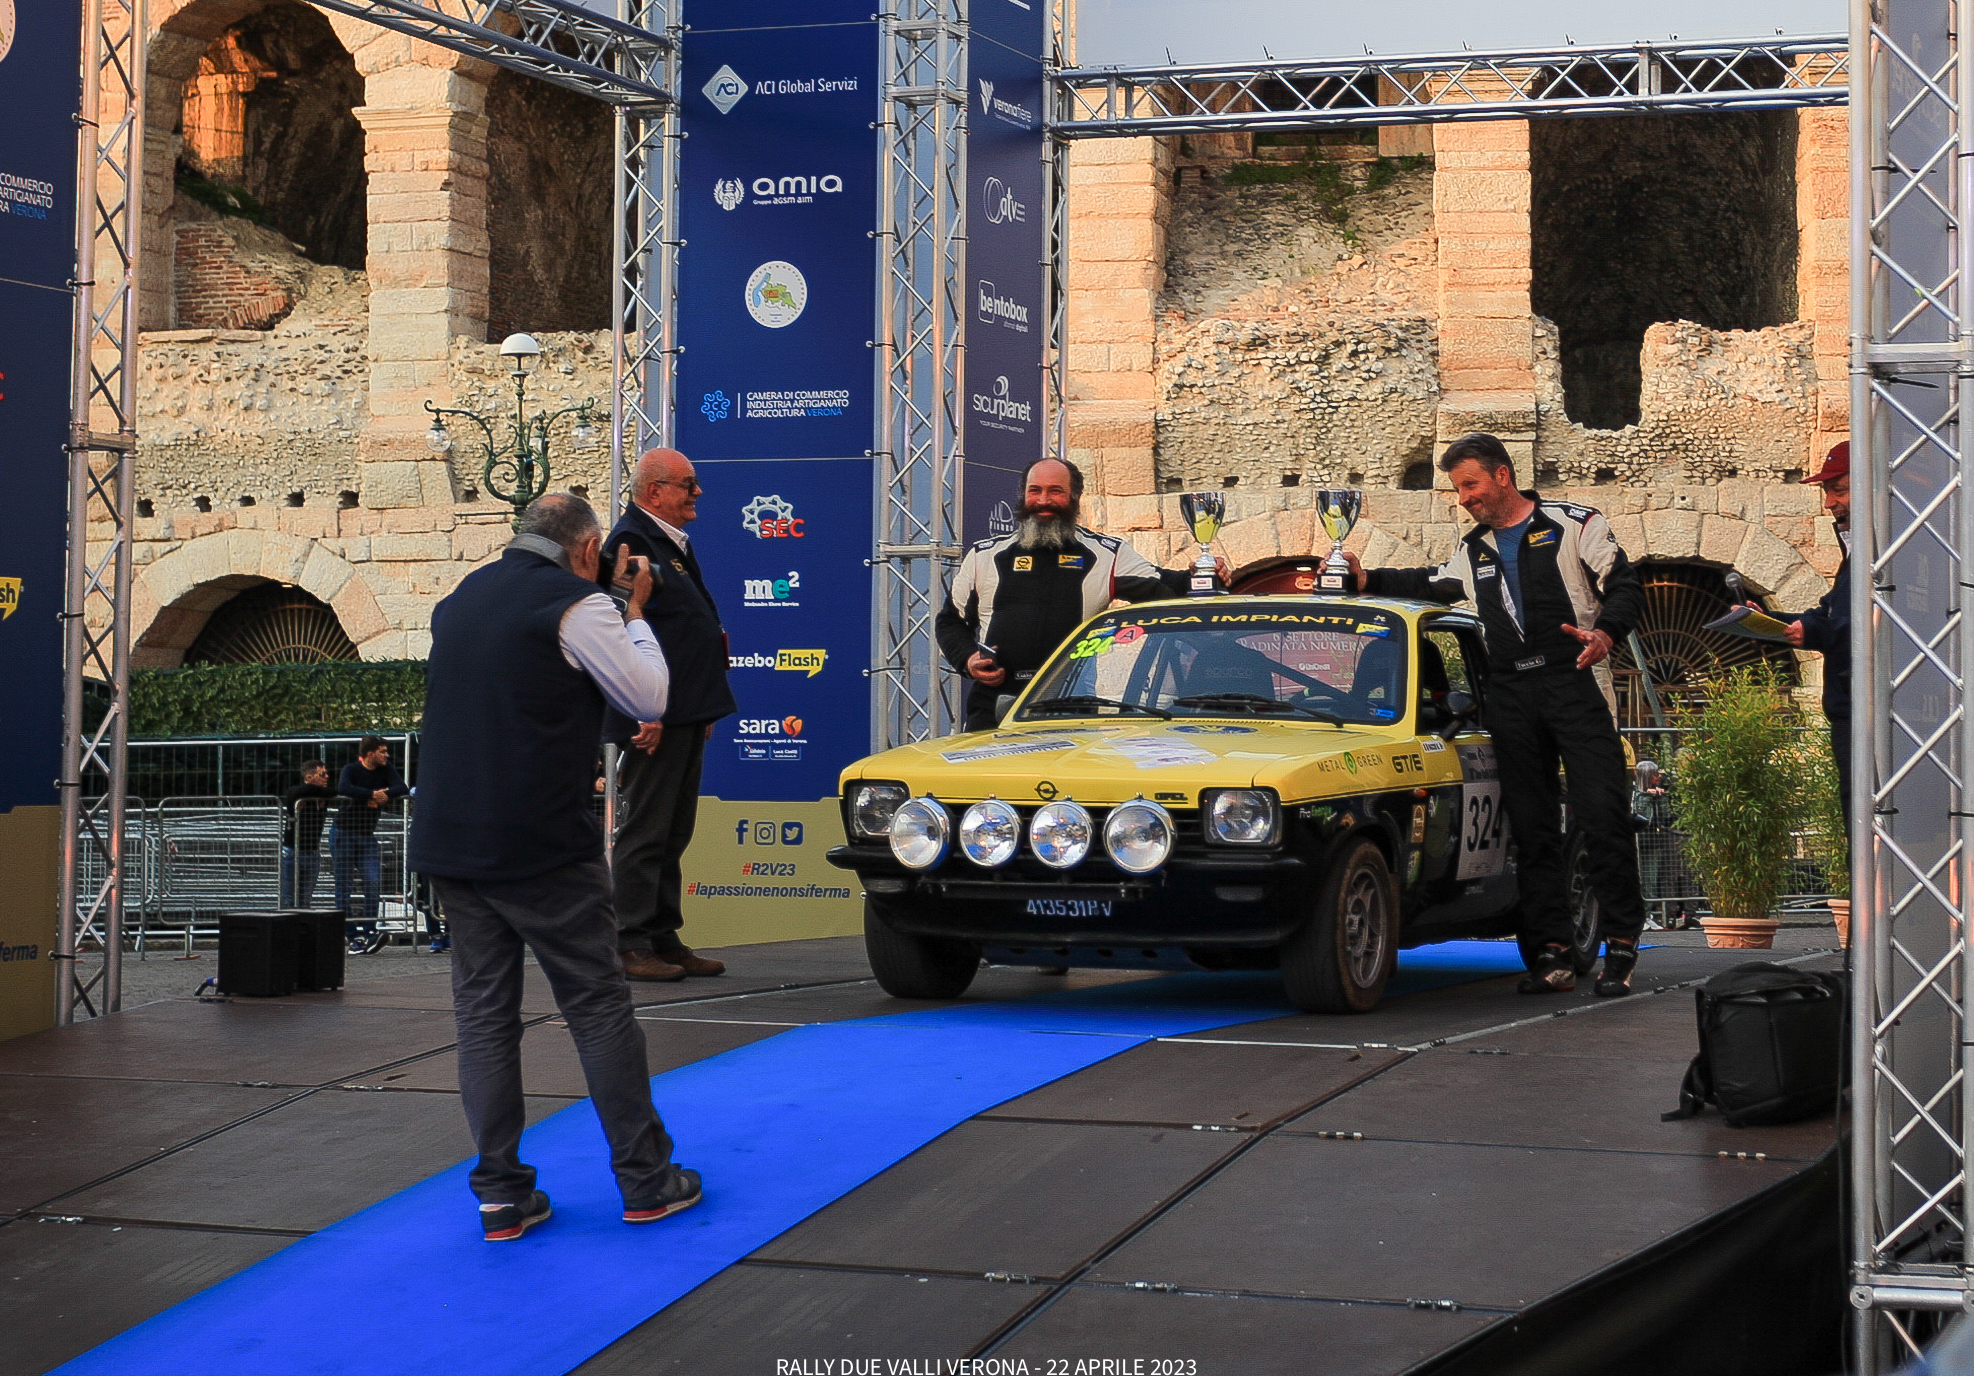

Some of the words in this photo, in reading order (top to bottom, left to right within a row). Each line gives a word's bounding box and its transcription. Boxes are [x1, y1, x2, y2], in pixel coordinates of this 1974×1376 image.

[755, 81, 776, 95] ACI
[778, 78, 815, 94] Global
[817, 76, 858, 92] Servizi
[752, 174, 843, 196] amia
[980, 288, 1029, 324] bentobox
[746, 391, 783, 400] CAMERA
[784, 391, 794, 400] DI
[794, 389, 849, 399] COMMERCIO
[746, 400, 792, 409] INDUSTRIA
[792, 398, 849, 408] ARTIGIANATO
[746, 408, 806, 418] AGRICOLTURA
[806, 407, 843, 417] VERONA
[760, 518, 805, 538] SEC
[1119, 615, 1203, 628] LUCA
[1211, 614, 1354, 626] IMPIANTI
[1286, 631, 1340, 642] SETTORE
[1069, 635, 1116, 660] 324
[728, 652, 775, 668] azebo
[738, 719, 780, 734] sara
[1316, 758, 1346, 774] METAL
[1356, 753, 1385, 768] GREEN
[742, 861, 796, 877] #R2V23
[686, 882, 851, 899] #lapassionenonsiferma
